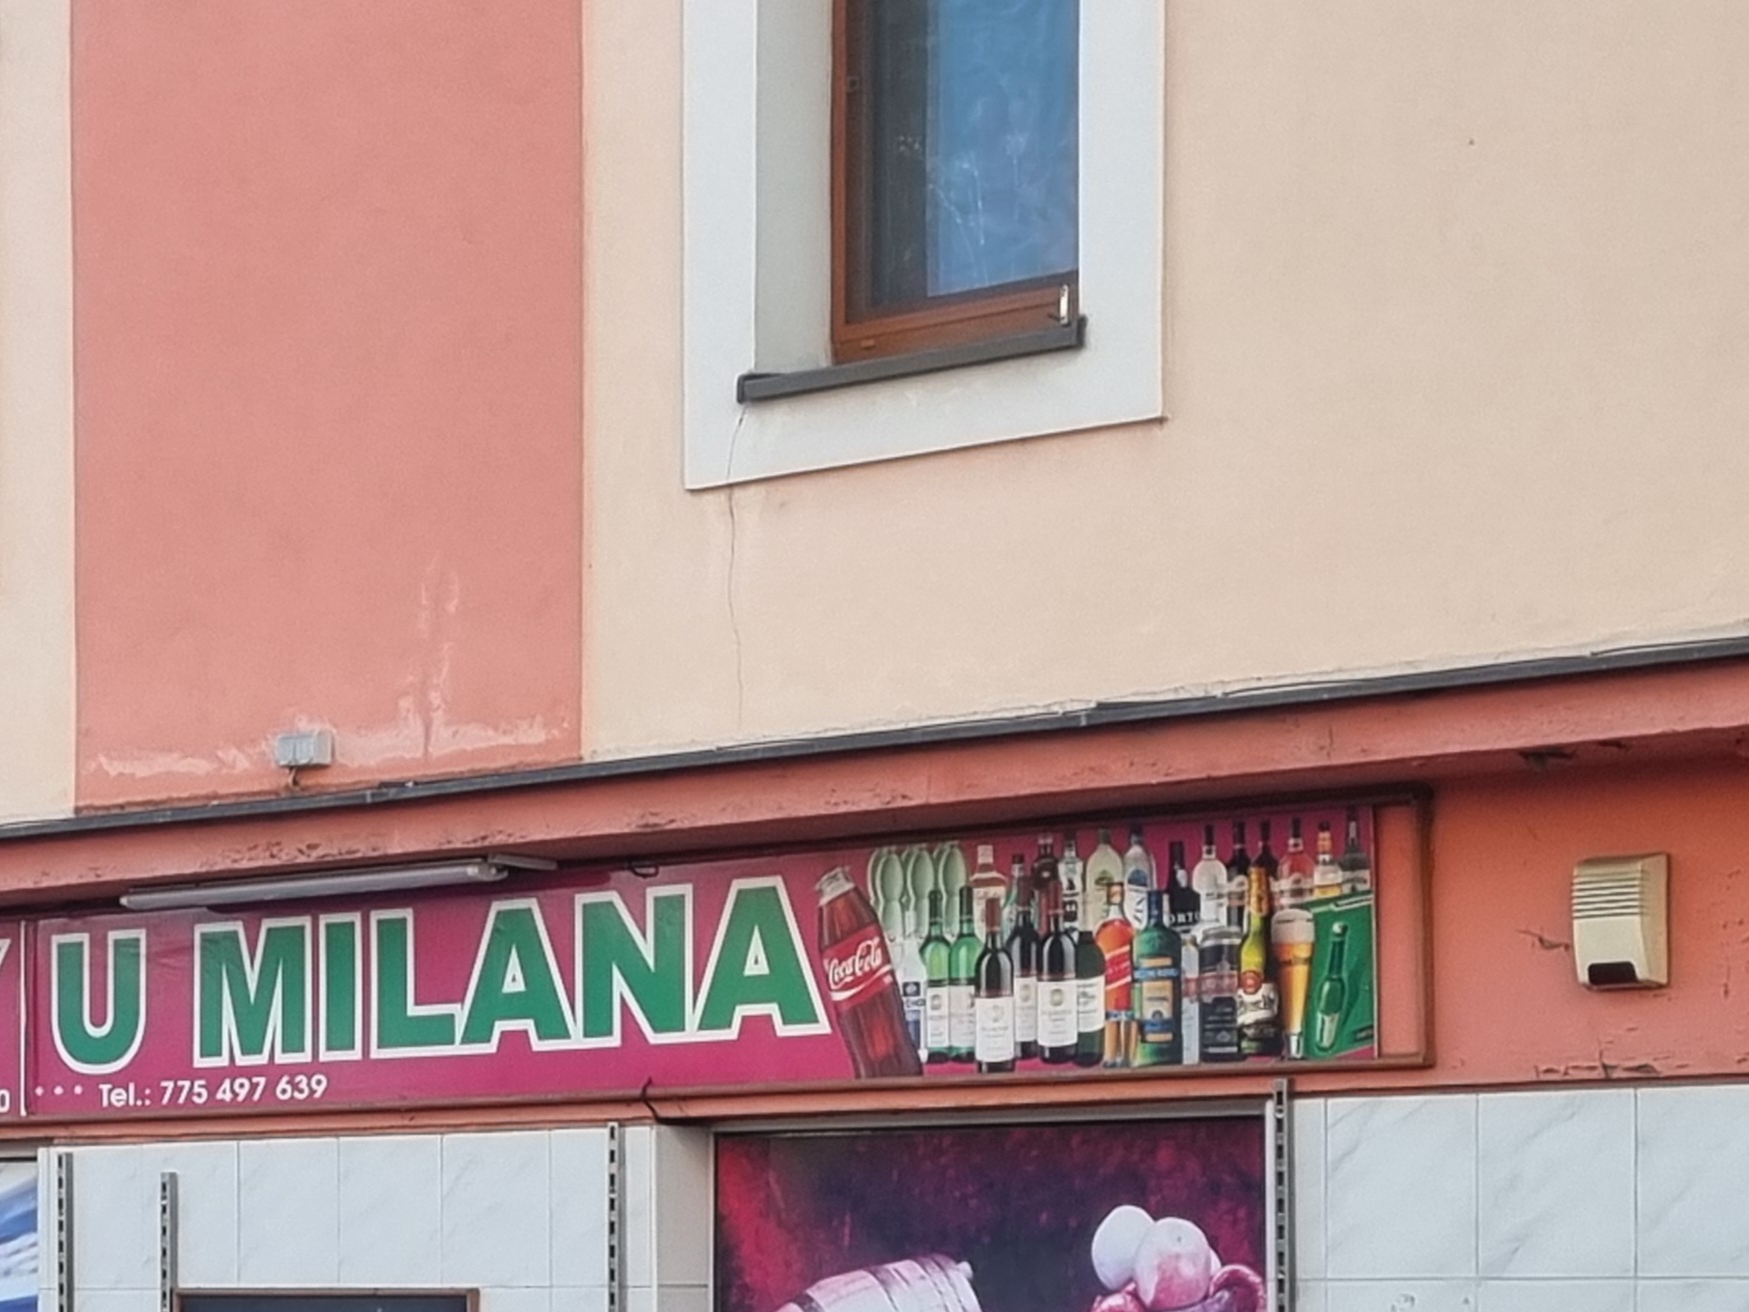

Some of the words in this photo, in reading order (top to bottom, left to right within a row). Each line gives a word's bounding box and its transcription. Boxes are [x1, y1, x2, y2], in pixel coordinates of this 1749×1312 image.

[52, 929, 147, 1075] U
[193, 875, 832, 1069] MILANA
[99, 1082, 151, 1108] Tel.:
[160, 1079, 208, 1106] 775
[215, 1076, 267, 1103] 497
[274, 1074, 328, 1101] 639
